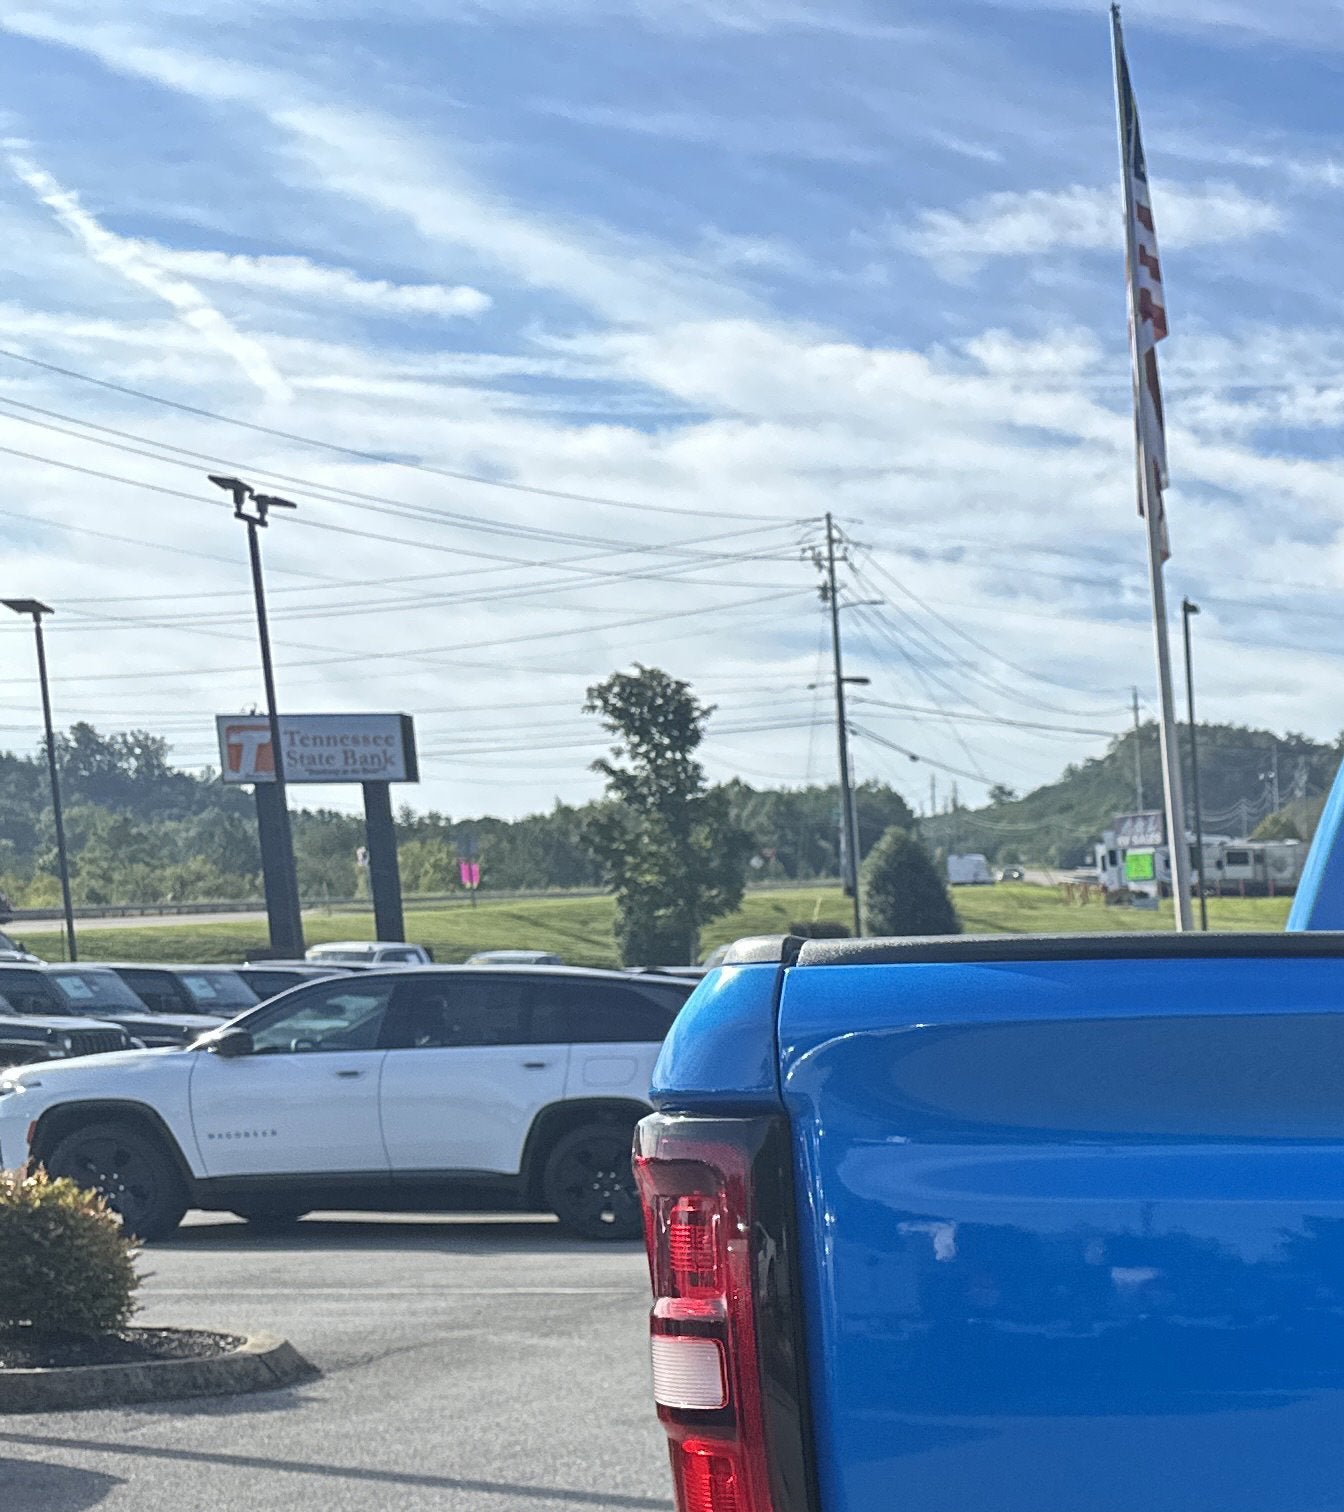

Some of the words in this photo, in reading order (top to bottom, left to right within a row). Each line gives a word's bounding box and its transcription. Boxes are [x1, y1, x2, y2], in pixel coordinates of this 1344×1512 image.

[284, 729, 396, 748] Tennessee
[286, 750, 336, 769] State
[343, 750, 395, 768] Bank
